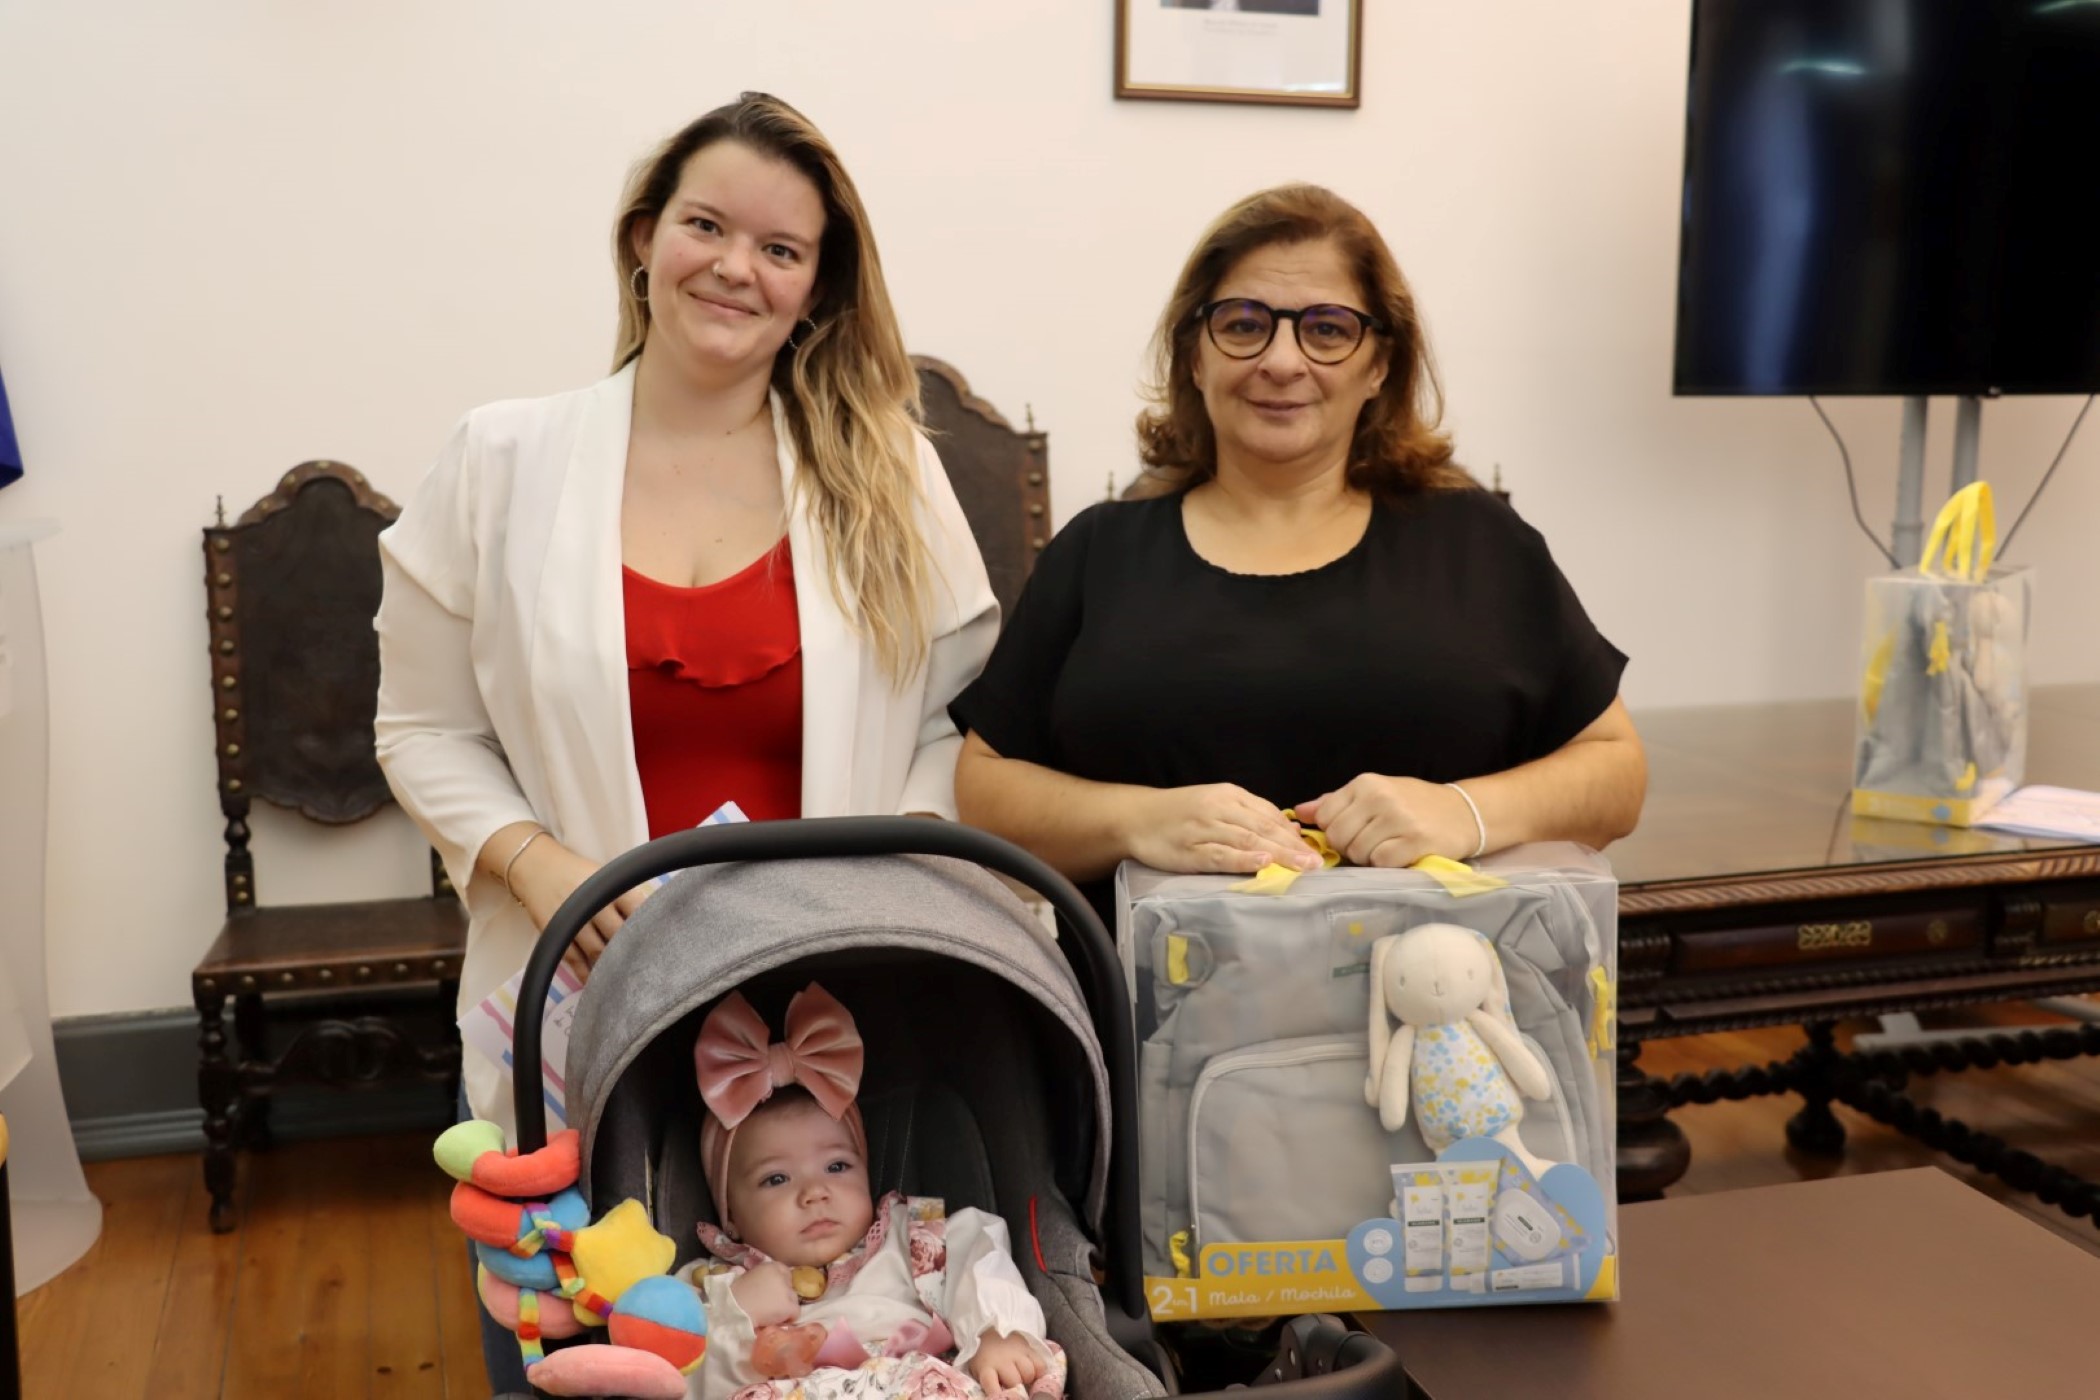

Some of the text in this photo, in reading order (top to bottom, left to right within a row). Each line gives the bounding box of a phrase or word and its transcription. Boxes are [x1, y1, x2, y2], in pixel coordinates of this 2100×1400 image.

[1208, 1250, 1337, 1276] OFERTA
[1152, 1286, 1173, 1314] 2
[1185, 1287, 1198, 1313] 1
[1209, 1292, 1259, 1306] Mala
[1281, 1286, 1355, 1302] Mochila
